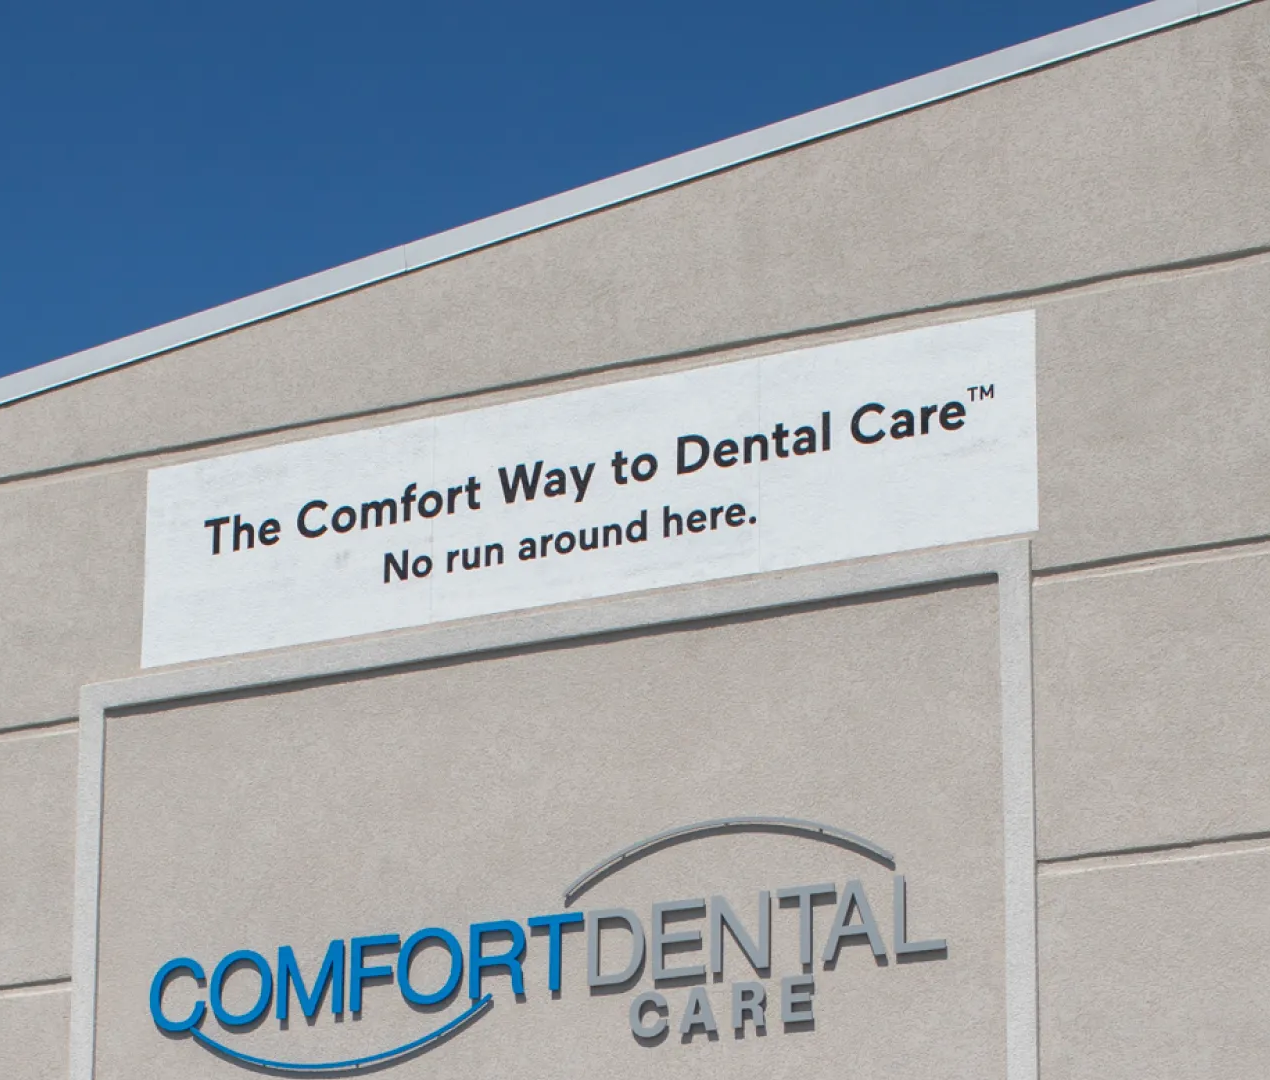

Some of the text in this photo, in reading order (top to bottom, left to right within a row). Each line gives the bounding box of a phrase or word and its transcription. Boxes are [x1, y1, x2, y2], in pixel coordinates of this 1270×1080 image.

[204, 516, 282, 556] The
[296, 475, 482, 538] Comfort
[498, 456, 596, 506] Way
[611, 449, 658, 485] to
[676, 412, 832, 473] Dental
[383, 496, 759, 584] No run around here.
[630, 975, 815, 1039] CARE
